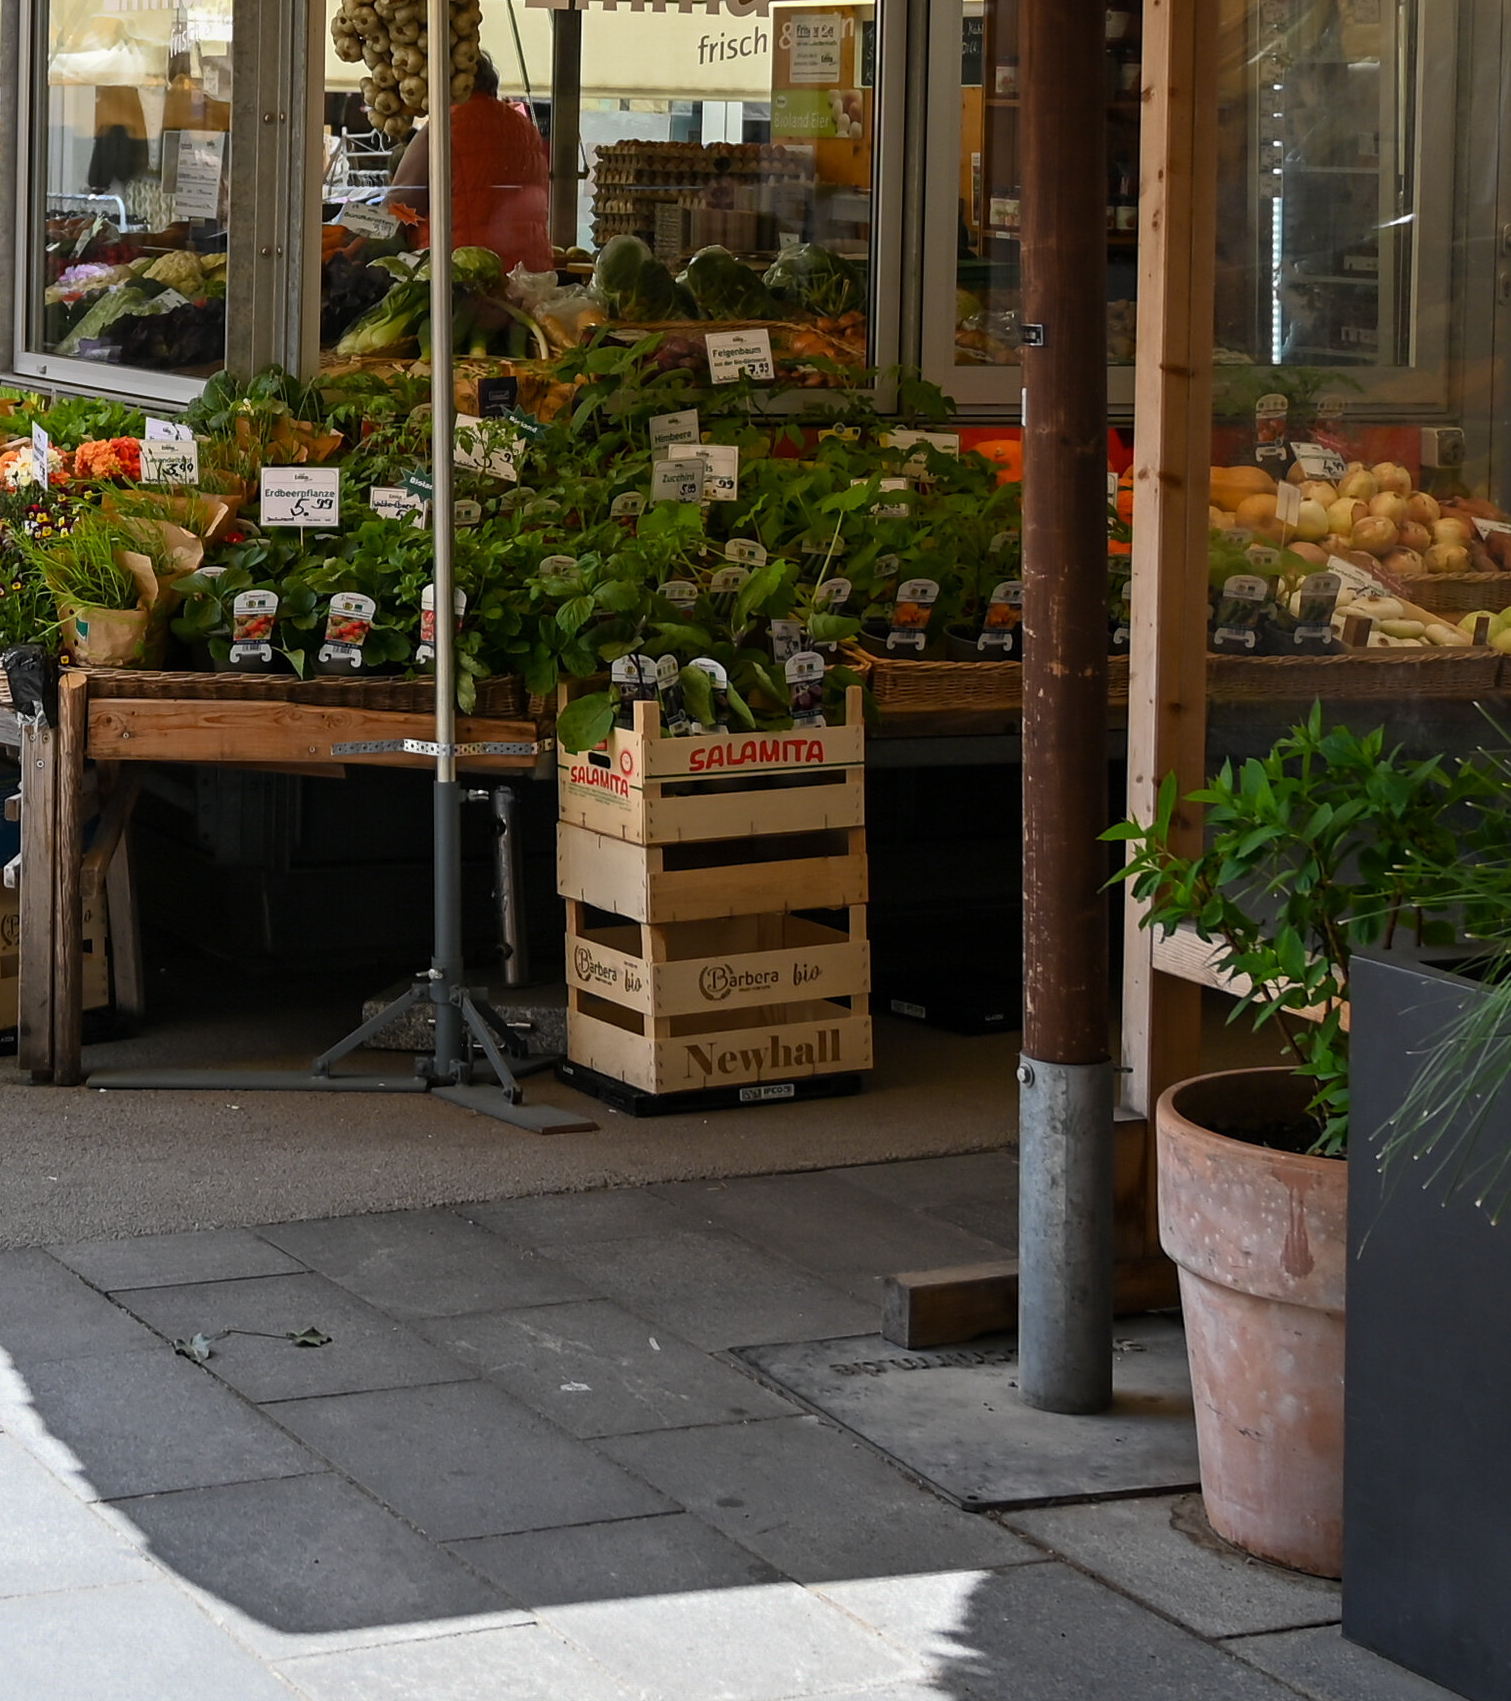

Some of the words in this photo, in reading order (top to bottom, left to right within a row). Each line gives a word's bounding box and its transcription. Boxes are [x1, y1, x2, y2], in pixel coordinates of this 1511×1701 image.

[697, 25, 769, 66] frisch
[774, 112, 809, 129] Bioland
[811, 112, 830, 129] Eier
[712, 346, 762, 359] Feigenbaum
[654, 431, 692, 444] Himbeere
[661, 470, 695, 484] Zucchini
[264, 488, 336, 499] Erdbeerpflanze
[290, 498, 334, 517] 5.99
[688, 738, 825, 772] SALAMITA
[570, 765, 629, 799] SALAMITA
[577, 947, 618, 982] Barbera
[624, 968, 643, 993] bio
[707, 966, 780, 993] Barbera
[792, 962, 824, 987] bio
[682, 1028, 842, 1079] Newhall
